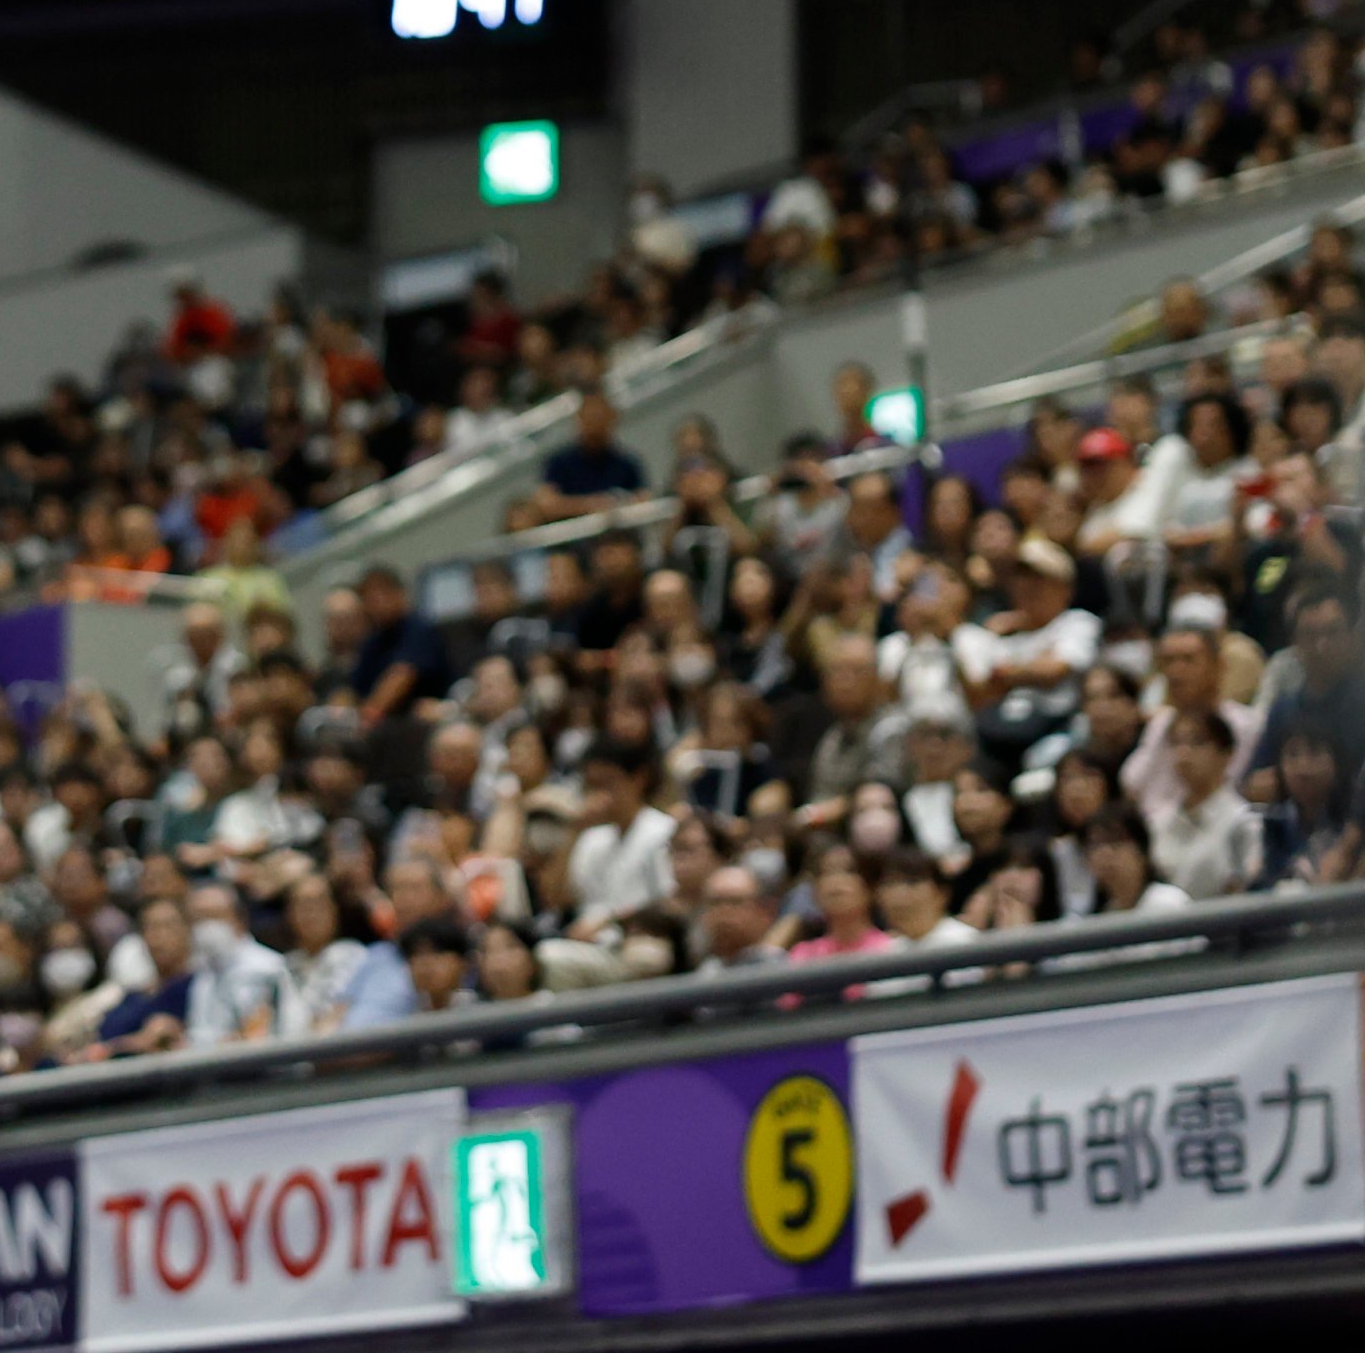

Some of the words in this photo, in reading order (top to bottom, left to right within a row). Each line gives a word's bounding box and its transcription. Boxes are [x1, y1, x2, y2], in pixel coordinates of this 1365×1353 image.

[778, 1127, 818, 1231] 5
[997, 1063, 1337, 1215] 中部電力
[100, 1156, 440, 1296] TOYOTA
